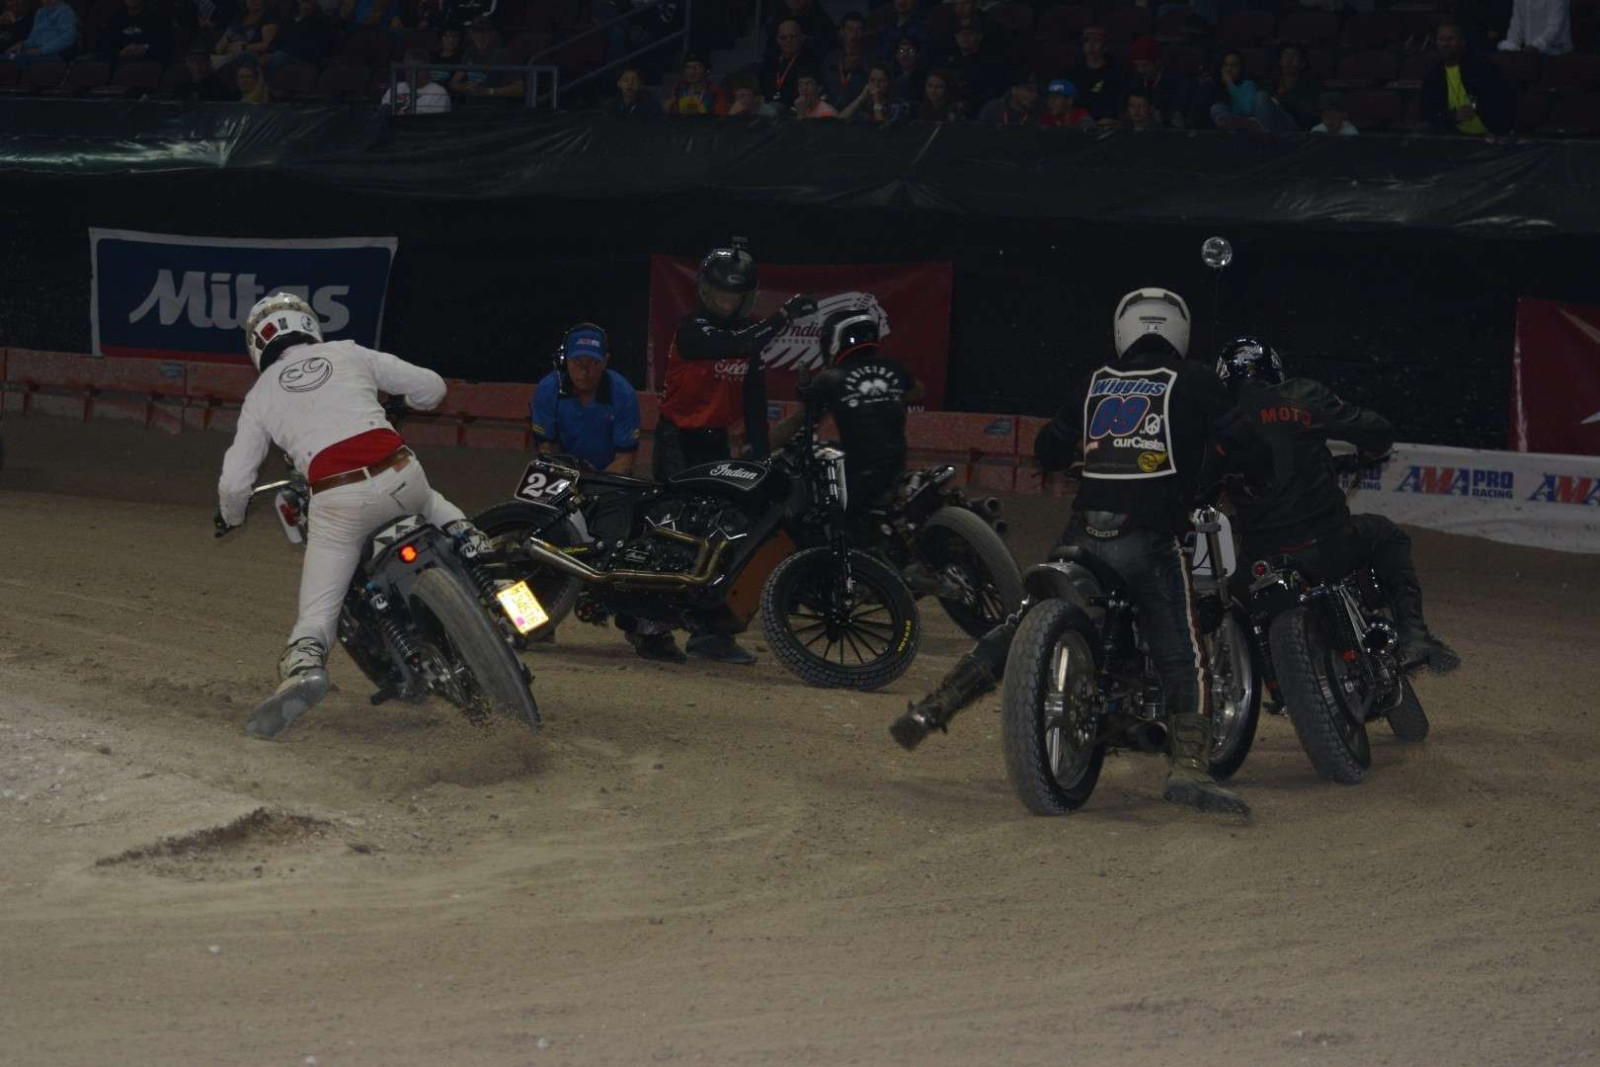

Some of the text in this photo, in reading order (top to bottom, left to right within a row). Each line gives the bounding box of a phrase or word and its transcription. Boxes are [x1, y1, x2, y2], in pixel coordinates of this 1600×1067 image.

[129, 269, 350, 333] Mits
[1259, 406, 1312, 428] MOTO
[709, 463, 758, 481] Indian
[1395, 465, 1470, 496] AMA
[1473, 469, 1514, 489] PRO
[522, 472, 573, 498] 24
[1342, 479, 1381, 491] RCING
[1472, 488, 1513, 499] RACING
